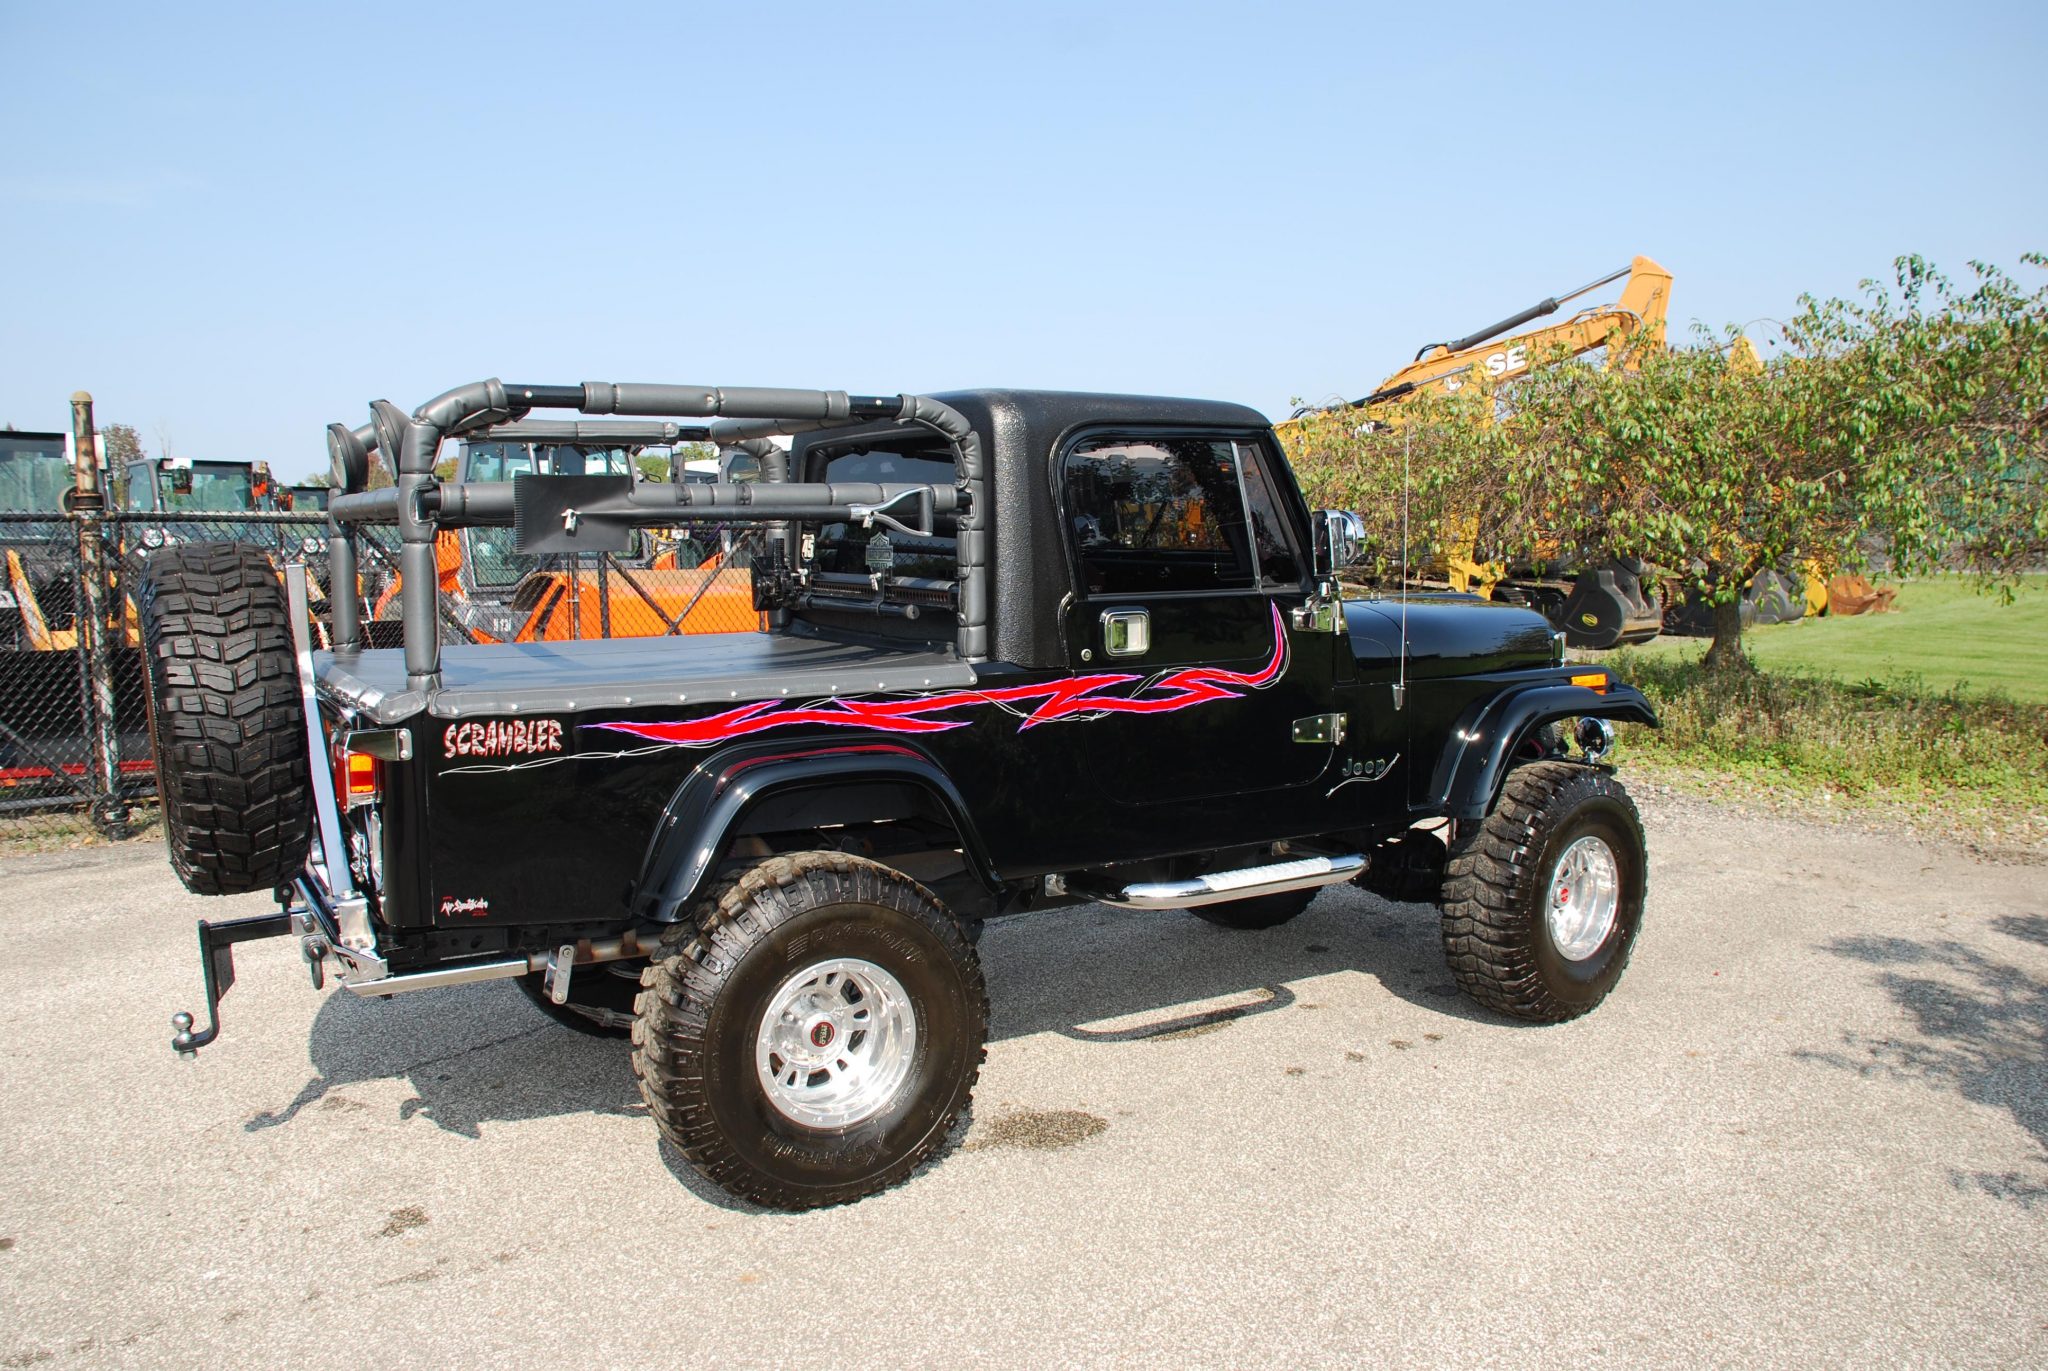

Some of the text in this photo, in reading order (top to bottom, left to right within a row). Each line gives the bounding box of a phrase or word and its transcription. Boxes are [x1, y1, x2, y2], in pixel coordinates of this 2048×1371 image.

[1444, 345, 1527, 391] CSE
[443, 718, 564, 760] SCRAMBLER
[1341, 758, 1386, 777] Jeep
